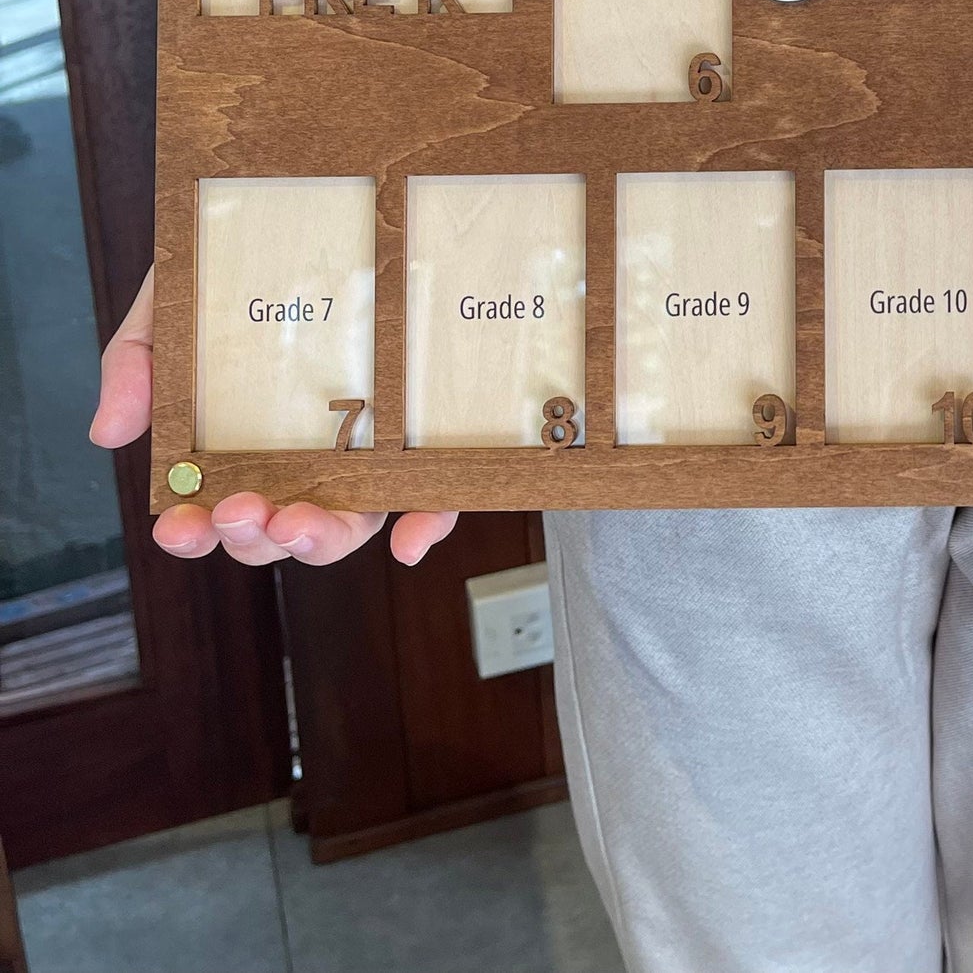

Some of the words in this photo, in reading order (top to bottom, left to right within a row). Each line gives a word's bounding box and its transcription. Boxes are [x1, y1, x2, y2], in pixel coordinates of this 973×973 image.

[688, 53, 724, 102] 6
[249, 297, 313, 322] Grade
[322, 298, 333, 321] 7
[460, 294, 525, 319] Grade
[533, 295, 544, 318] 8
[666, 291, 730, 316] Grade
[738, 292, 749, 315] 9
[871, 289, 934, 313] Grade
[944, 290, 967, 313] 10
[328, 399, 365, 451] 7
[541, 396, 579, 449] 8
[752, 394, 788, 446] 9
